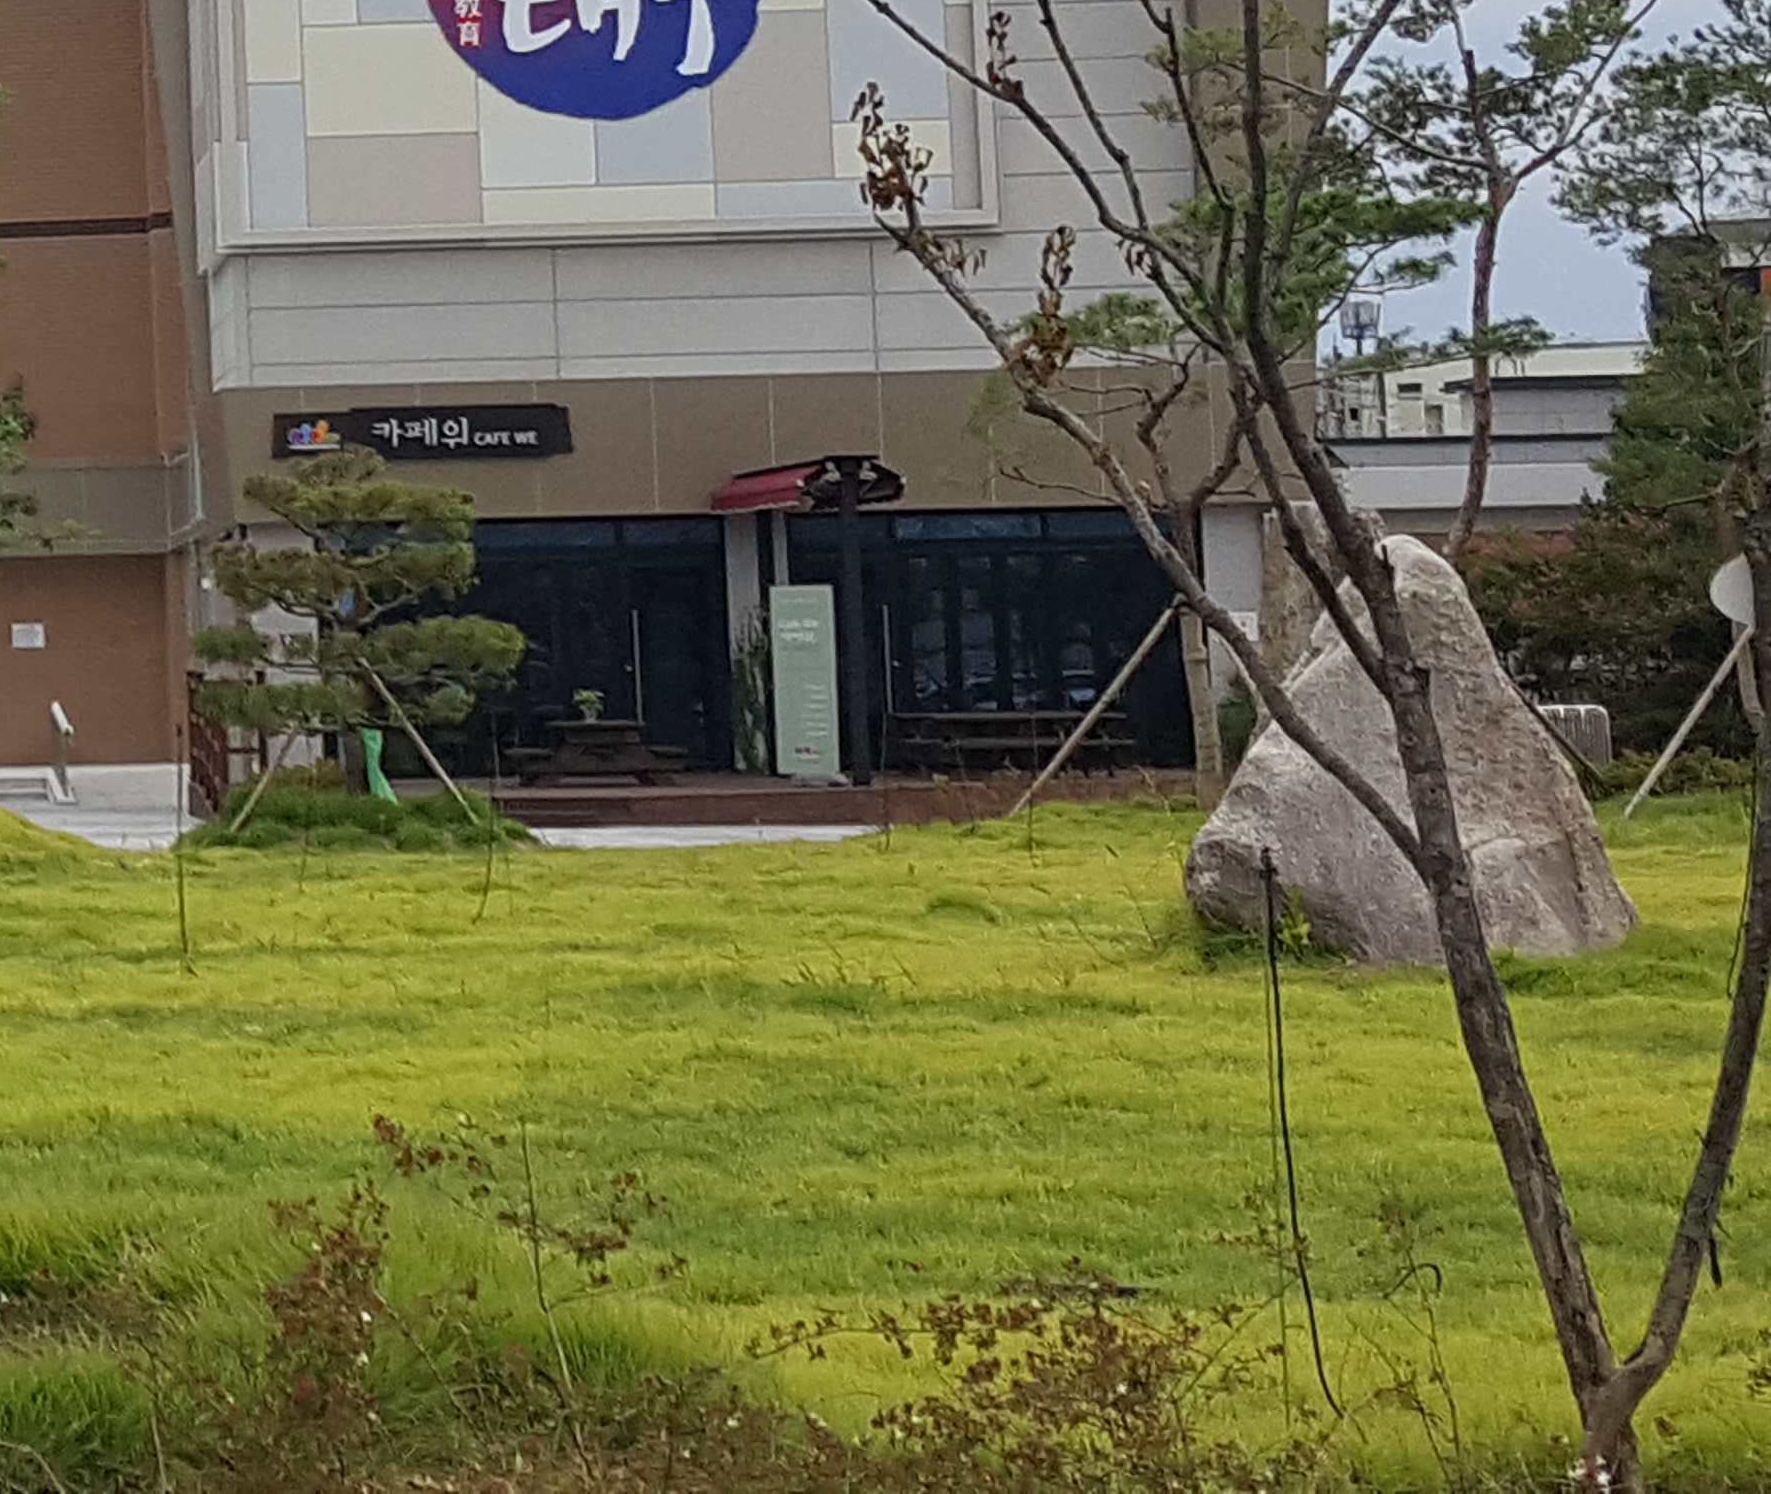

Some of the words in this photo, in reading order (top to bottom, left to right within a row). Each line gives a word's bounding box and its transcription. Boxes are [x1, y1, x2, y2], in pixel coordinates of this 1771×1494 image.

[370, 417, 469, 449] 카페위
[473, 431, 510, 446] CAFE
[513, 431, 539, 445] WE
